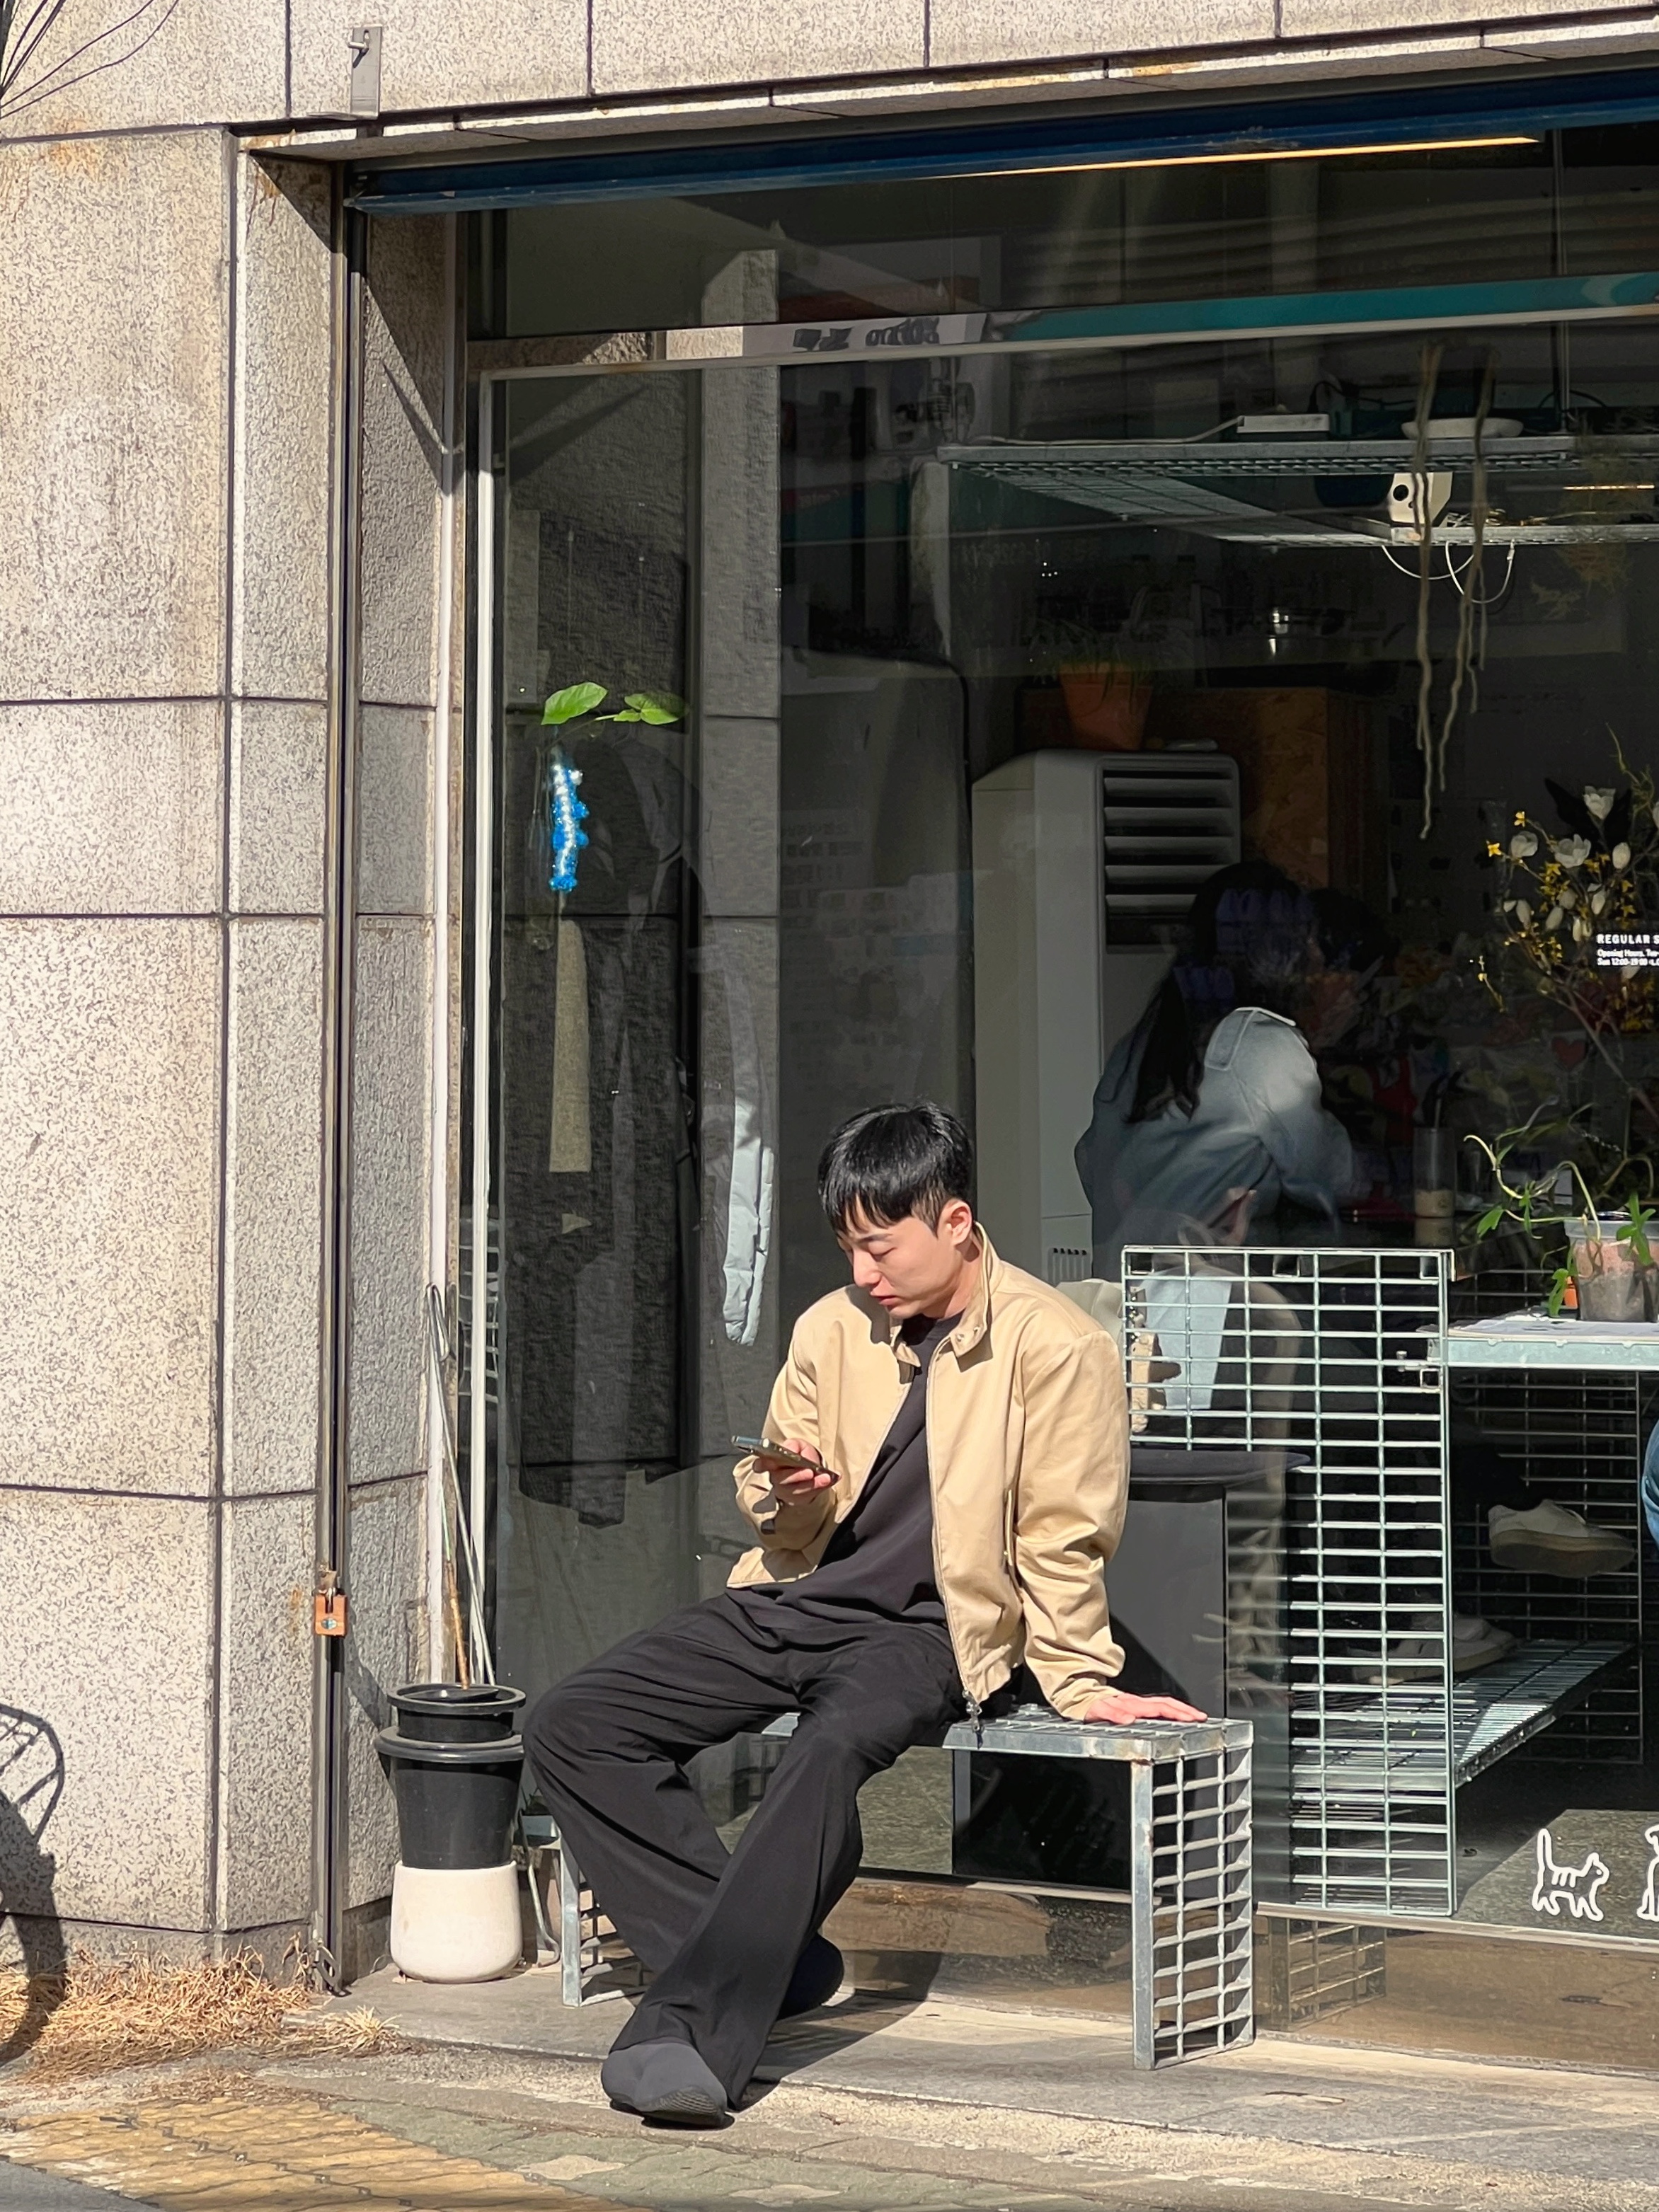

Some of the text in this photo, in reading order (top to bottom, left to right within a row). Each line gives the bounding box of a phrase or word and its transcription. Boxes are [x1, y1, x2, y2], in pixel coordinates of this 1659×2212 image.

[1597, 934, 1650, 944] REGULAR
[1597, 949, 1624, 957] Opening
[1597, 957, 1610, 966] Sun
